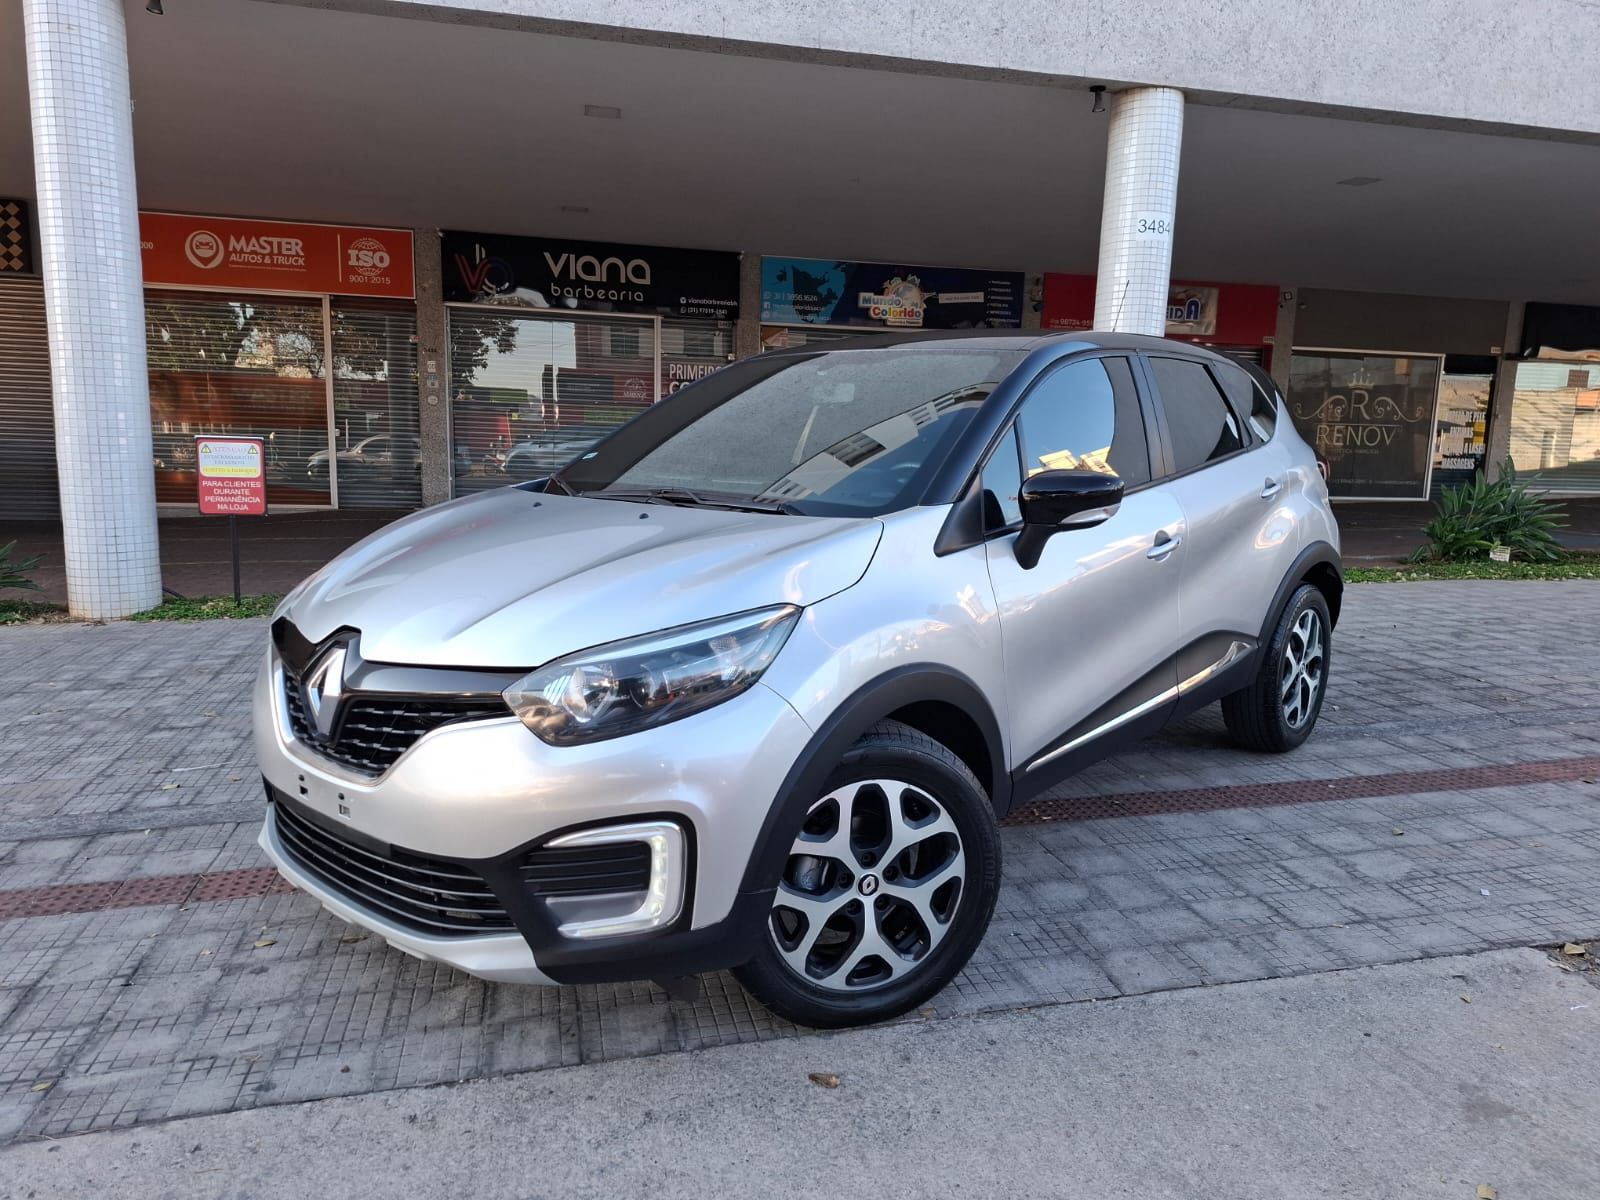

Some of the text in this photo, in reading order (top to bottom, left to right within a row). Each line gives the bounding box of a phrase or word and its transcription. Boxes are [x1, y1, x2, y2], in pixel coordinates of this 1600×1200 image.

[1138, 218, 1170, 234] 3484
[229, 234, 305, 257] MASTER
[229, 253, 306, 267] AUTOS & TRUCK
[347, 249, 391, 268] ISO
[550, 282, 645, 302] barbearia
[862, 295, 902, 307] Mundo
[872, 306, 922, 318] Colorido
[1350, 390, 1371, 421] R
[1316, 425, 1396, 446] RENOV
[205, 495, 261, 503] PERMANÊNCIA
[213, 488, 250, 496] DURANTE
[217, 503, 229, 511] NA
